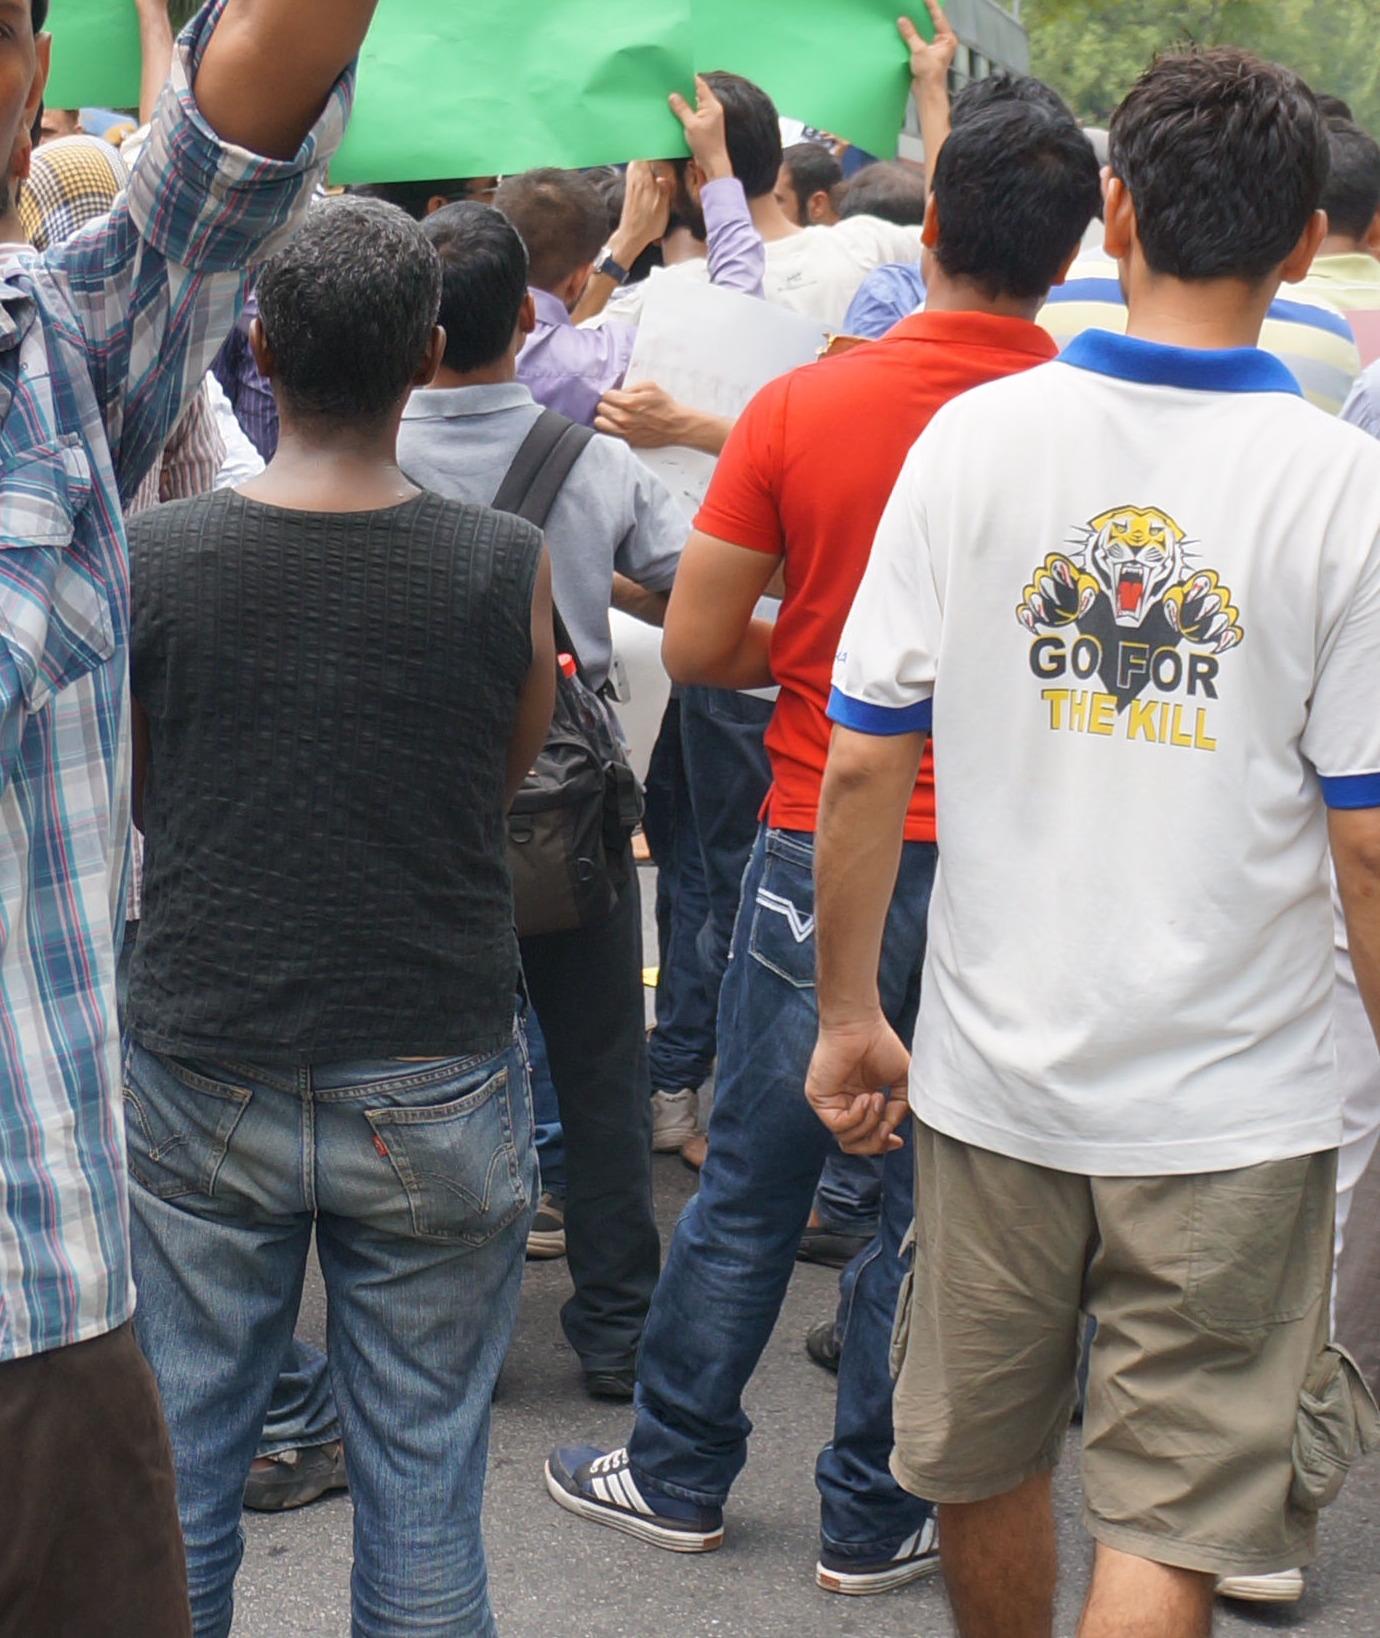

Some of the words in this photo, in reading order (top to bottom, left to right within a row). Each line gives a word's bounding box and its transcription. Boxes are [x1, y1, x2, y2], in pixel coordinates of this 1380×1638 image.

[1028, 633, 1102, 680] GO
[1116, 640, 1220, 700] FOR
[1041, 688, 1118, 736] THE
[1126, 698, 1217, 751] KILL
